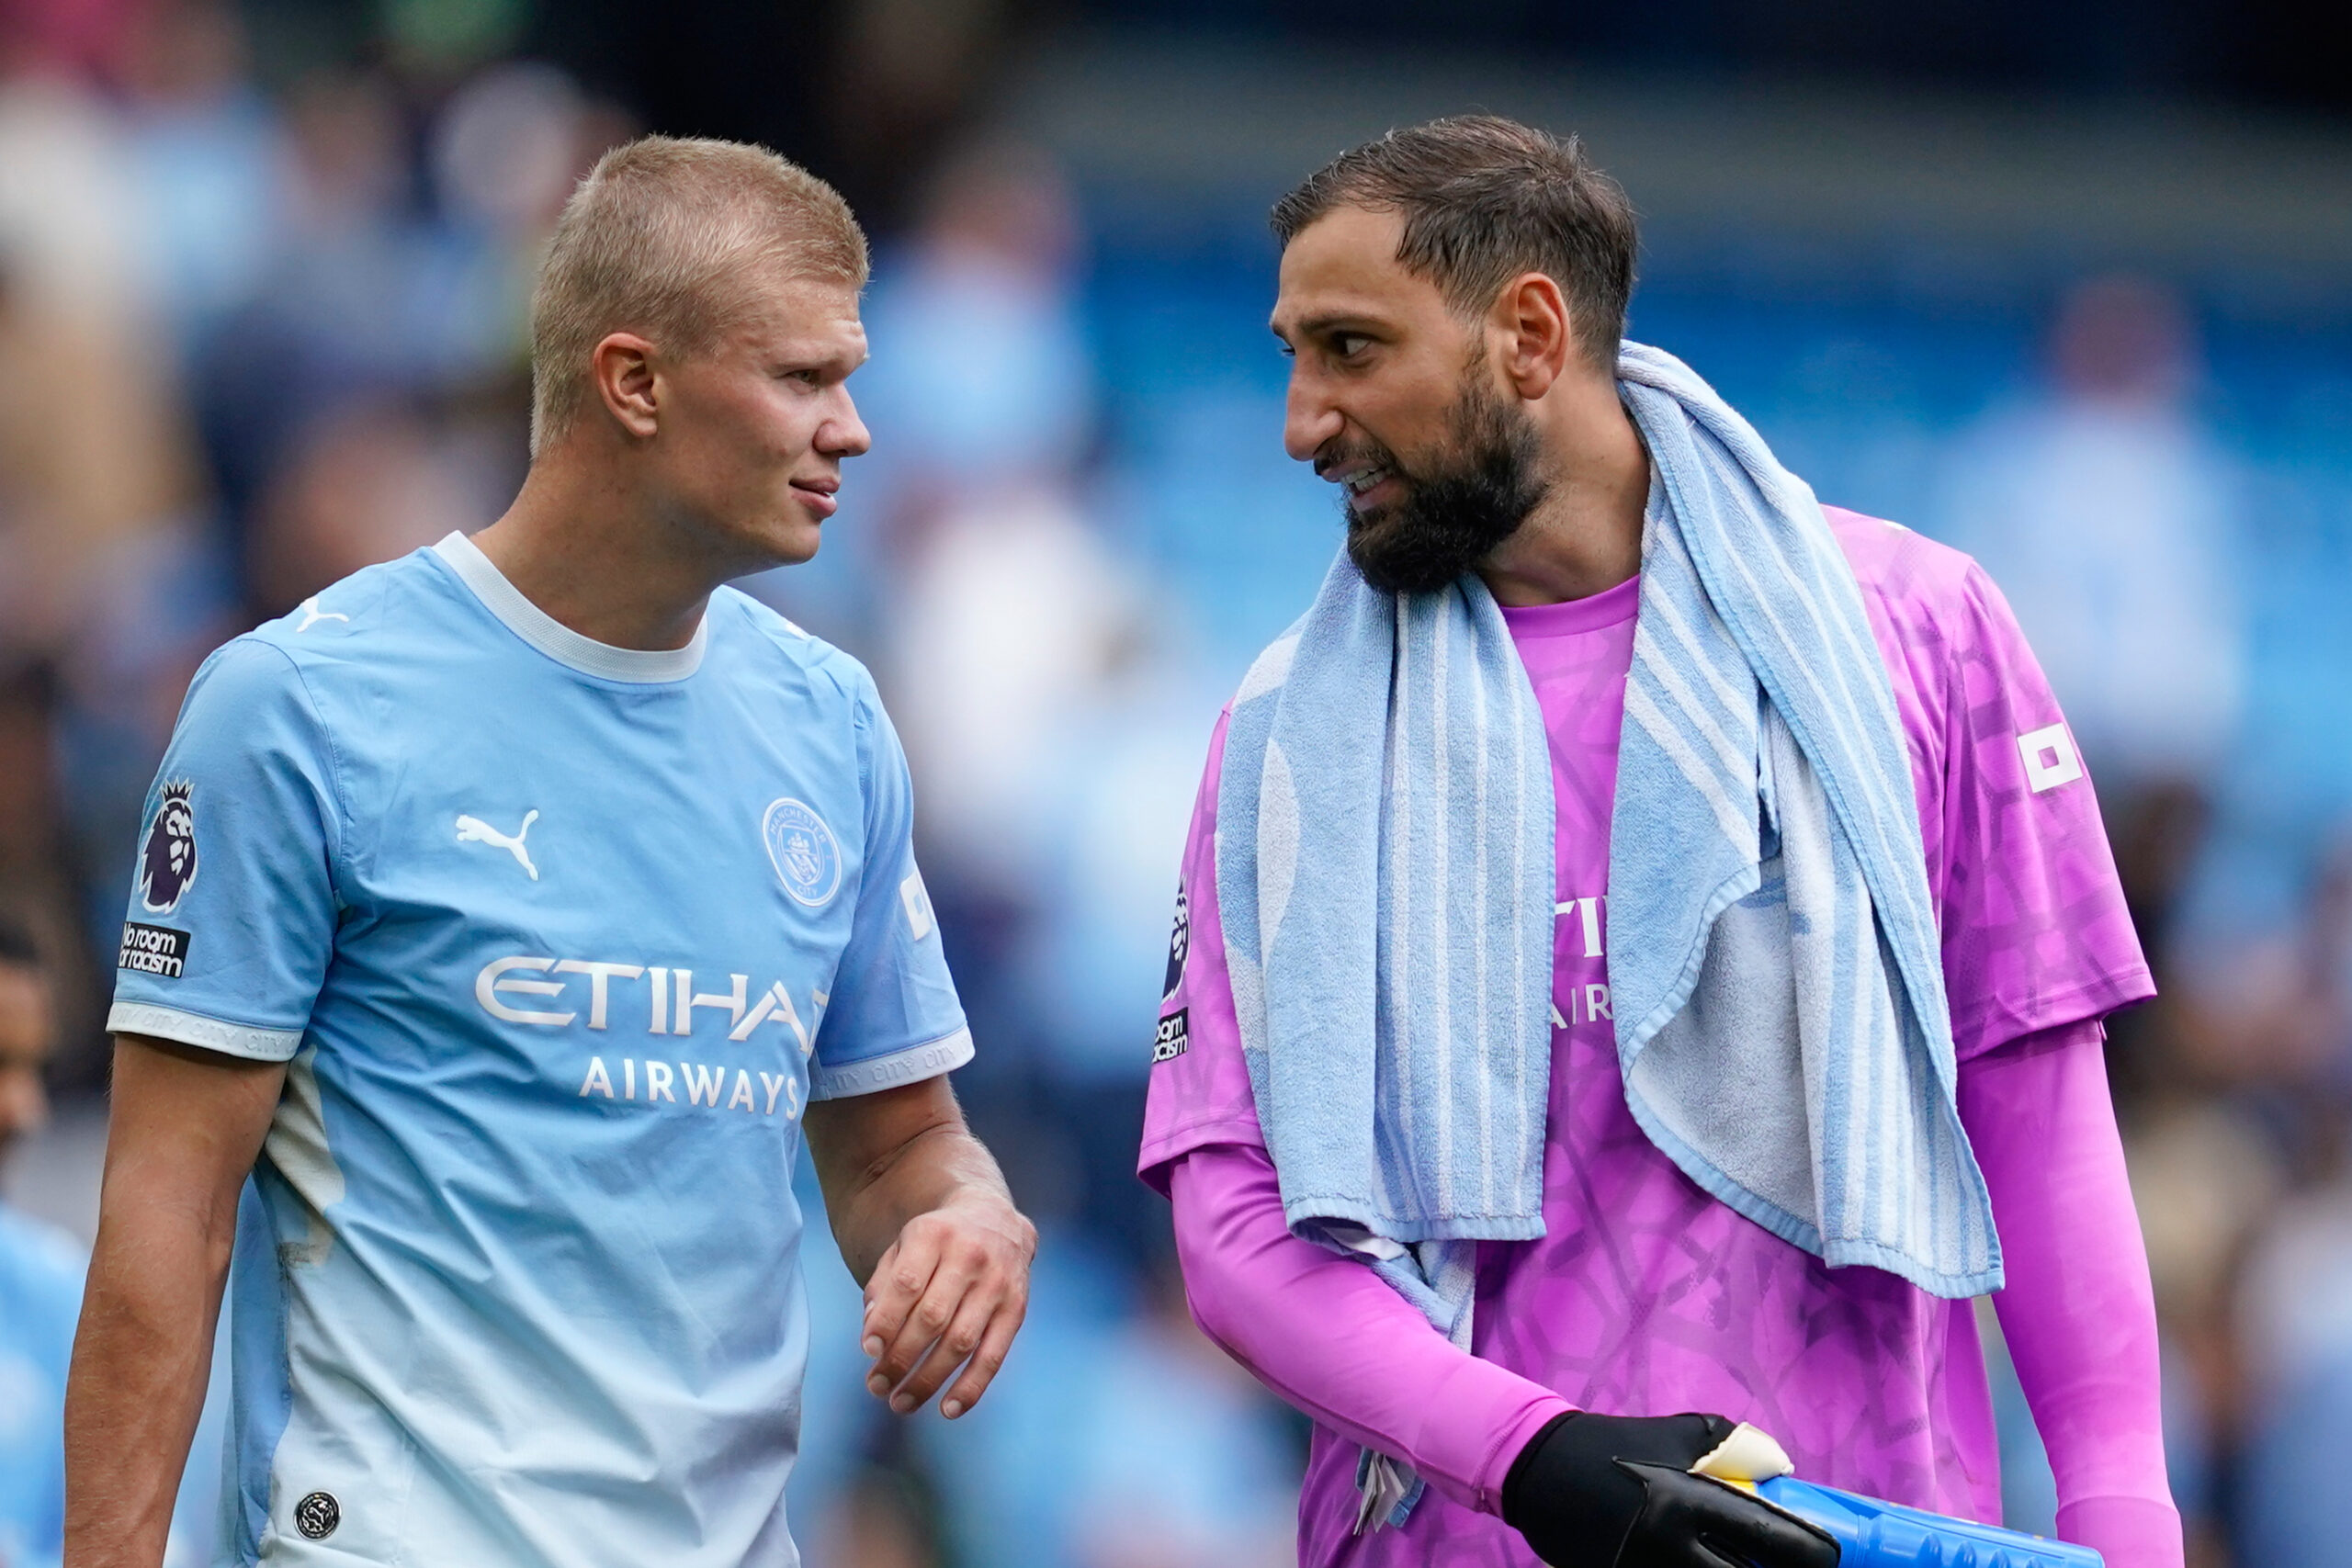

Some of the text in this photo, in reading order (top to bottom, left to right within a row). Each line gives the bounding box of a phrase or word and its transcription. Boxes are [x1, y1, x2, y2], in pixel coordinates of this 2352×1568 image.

[769, 807, 827, 843] MANCHESTER
[797, 886, 818, 897] CITY
[133, 929, 176, 954] room
[128, 950, 183, 977] racism
[579, 1055, 798, 1121] AIRWAYS
